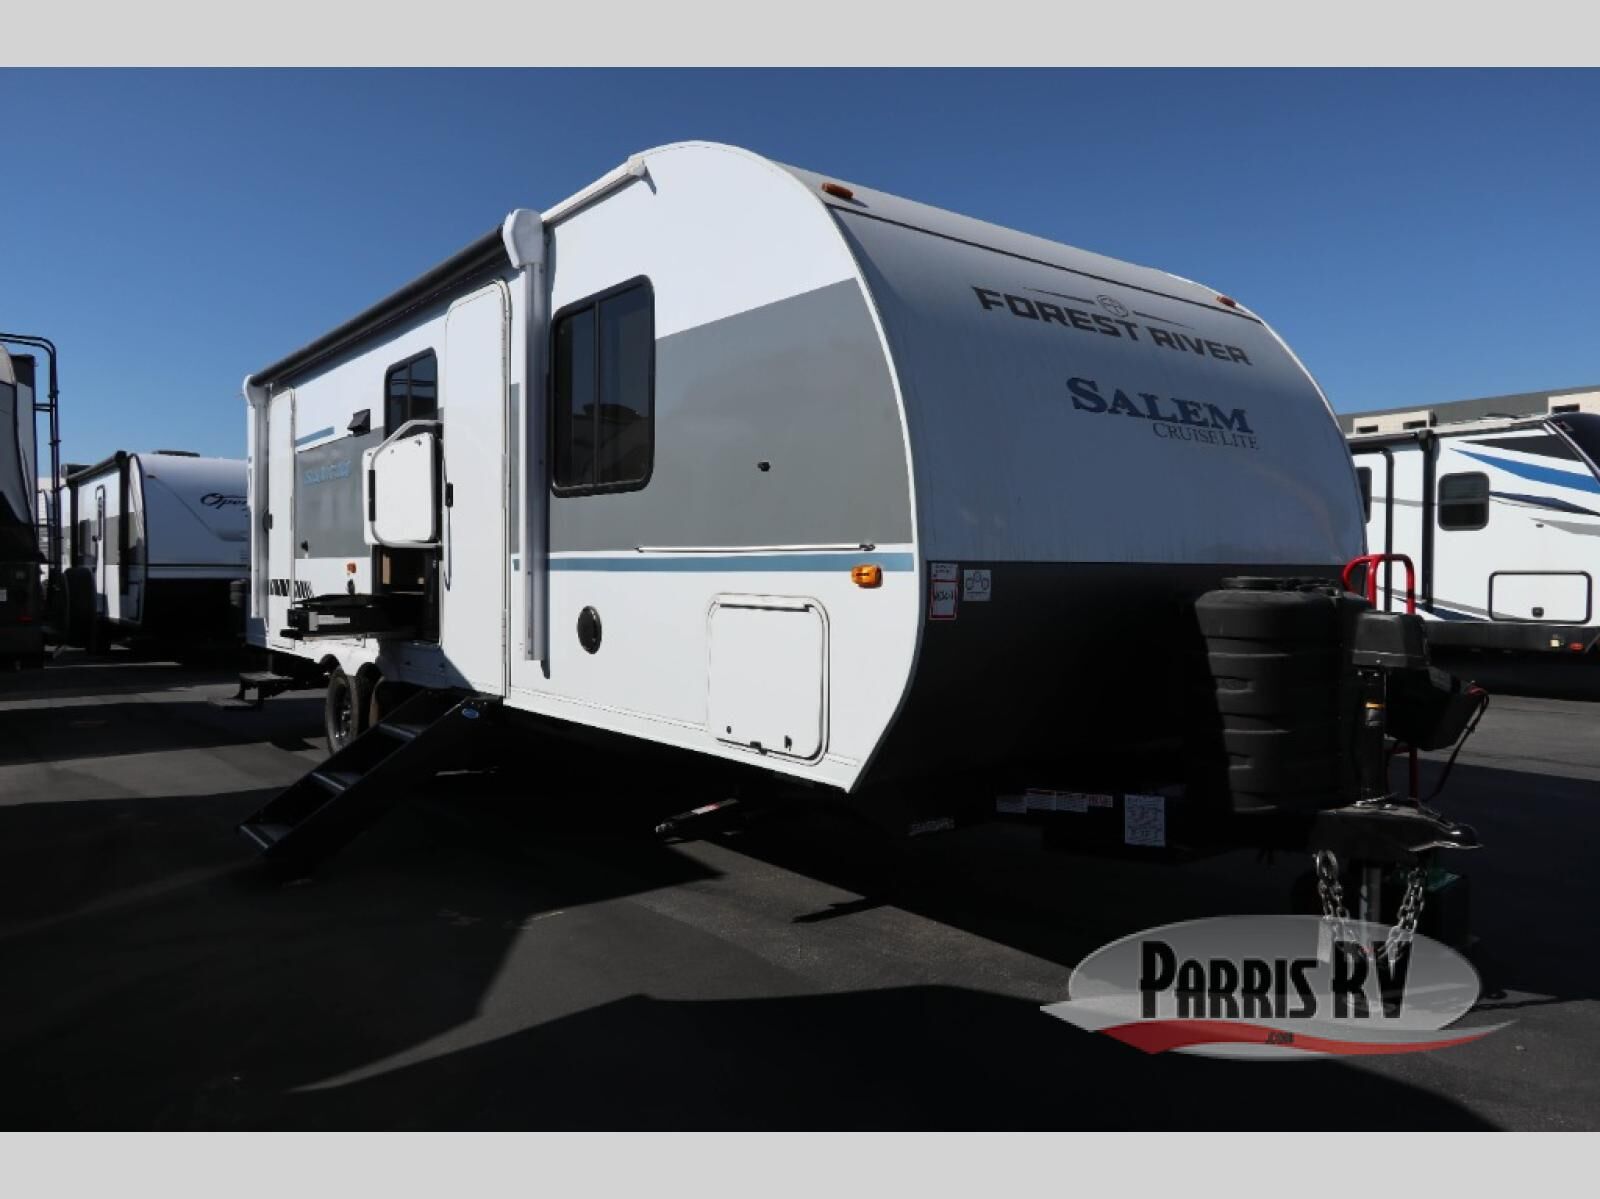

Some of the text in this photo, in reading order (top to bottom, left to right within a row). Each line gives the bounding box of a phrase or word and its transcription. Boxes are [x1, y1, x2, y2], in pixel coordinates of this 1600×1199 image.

[971, 286, 1253, 366] FOREST RIVER
[1065, 376, 1254, 434] SALEM
